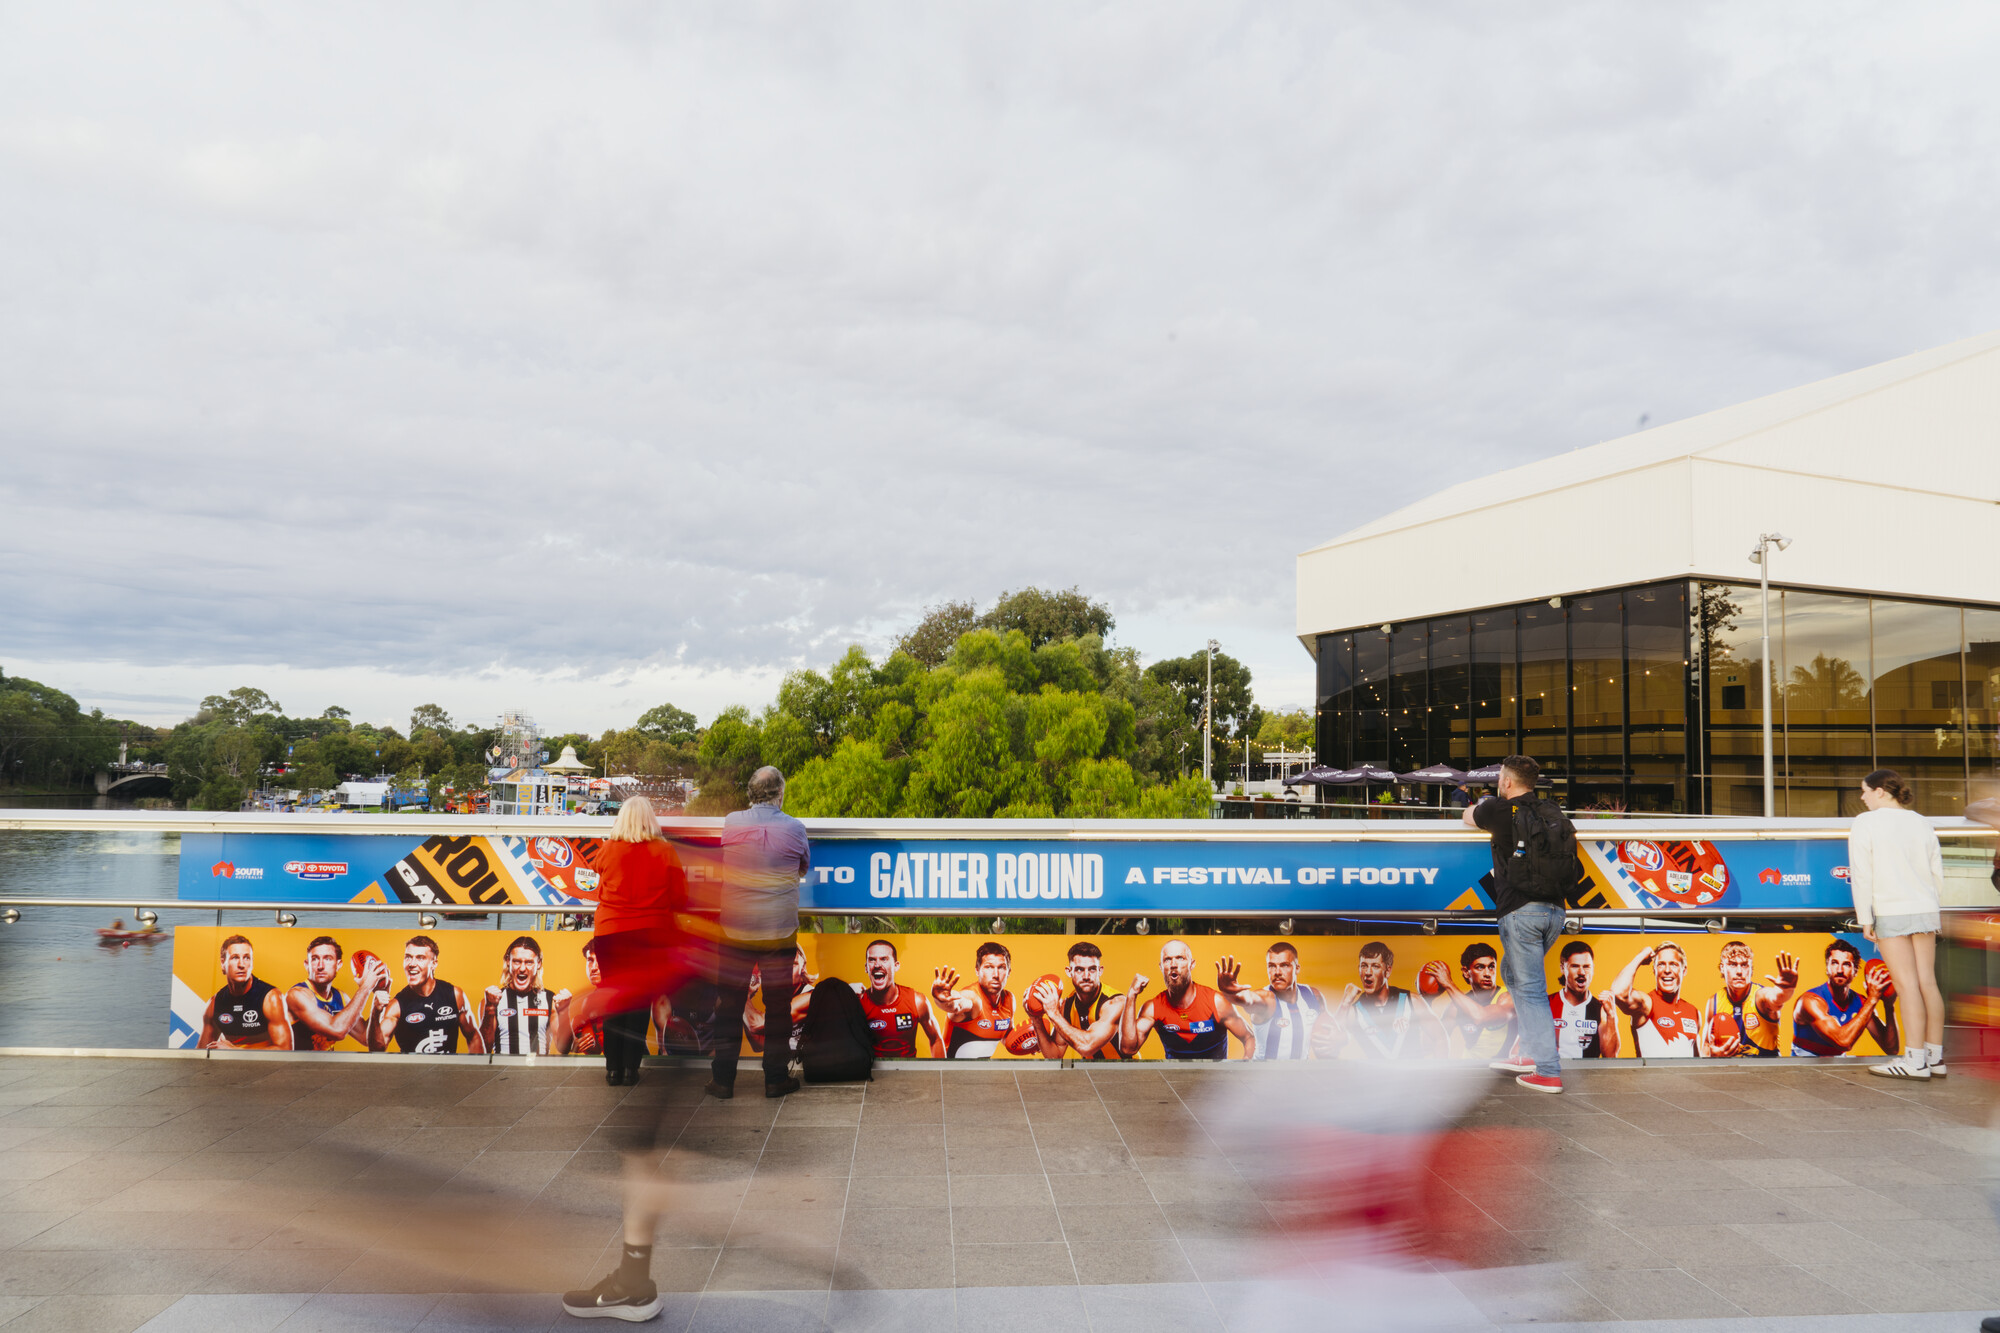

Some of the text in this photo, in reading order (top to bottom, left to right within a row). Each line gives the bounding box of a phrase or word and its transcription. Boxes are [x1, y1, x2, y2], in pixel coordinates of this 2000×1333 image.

[285, 863, 304, 871] AFL
[235, 868, 263, 876] SOUTH
[815, 866, 855, 883] TO
[870, 852, 1104, 899] GATHER ROUND
[1125, 867, 1439, 885] A FESTIVAL OF FOOTY
[1669, 872, 1689, 881] ADELAIDE
[1782, 874, 1811, 882] SOUTH
[1191, 1025, 1213, 1034] ZURICH
